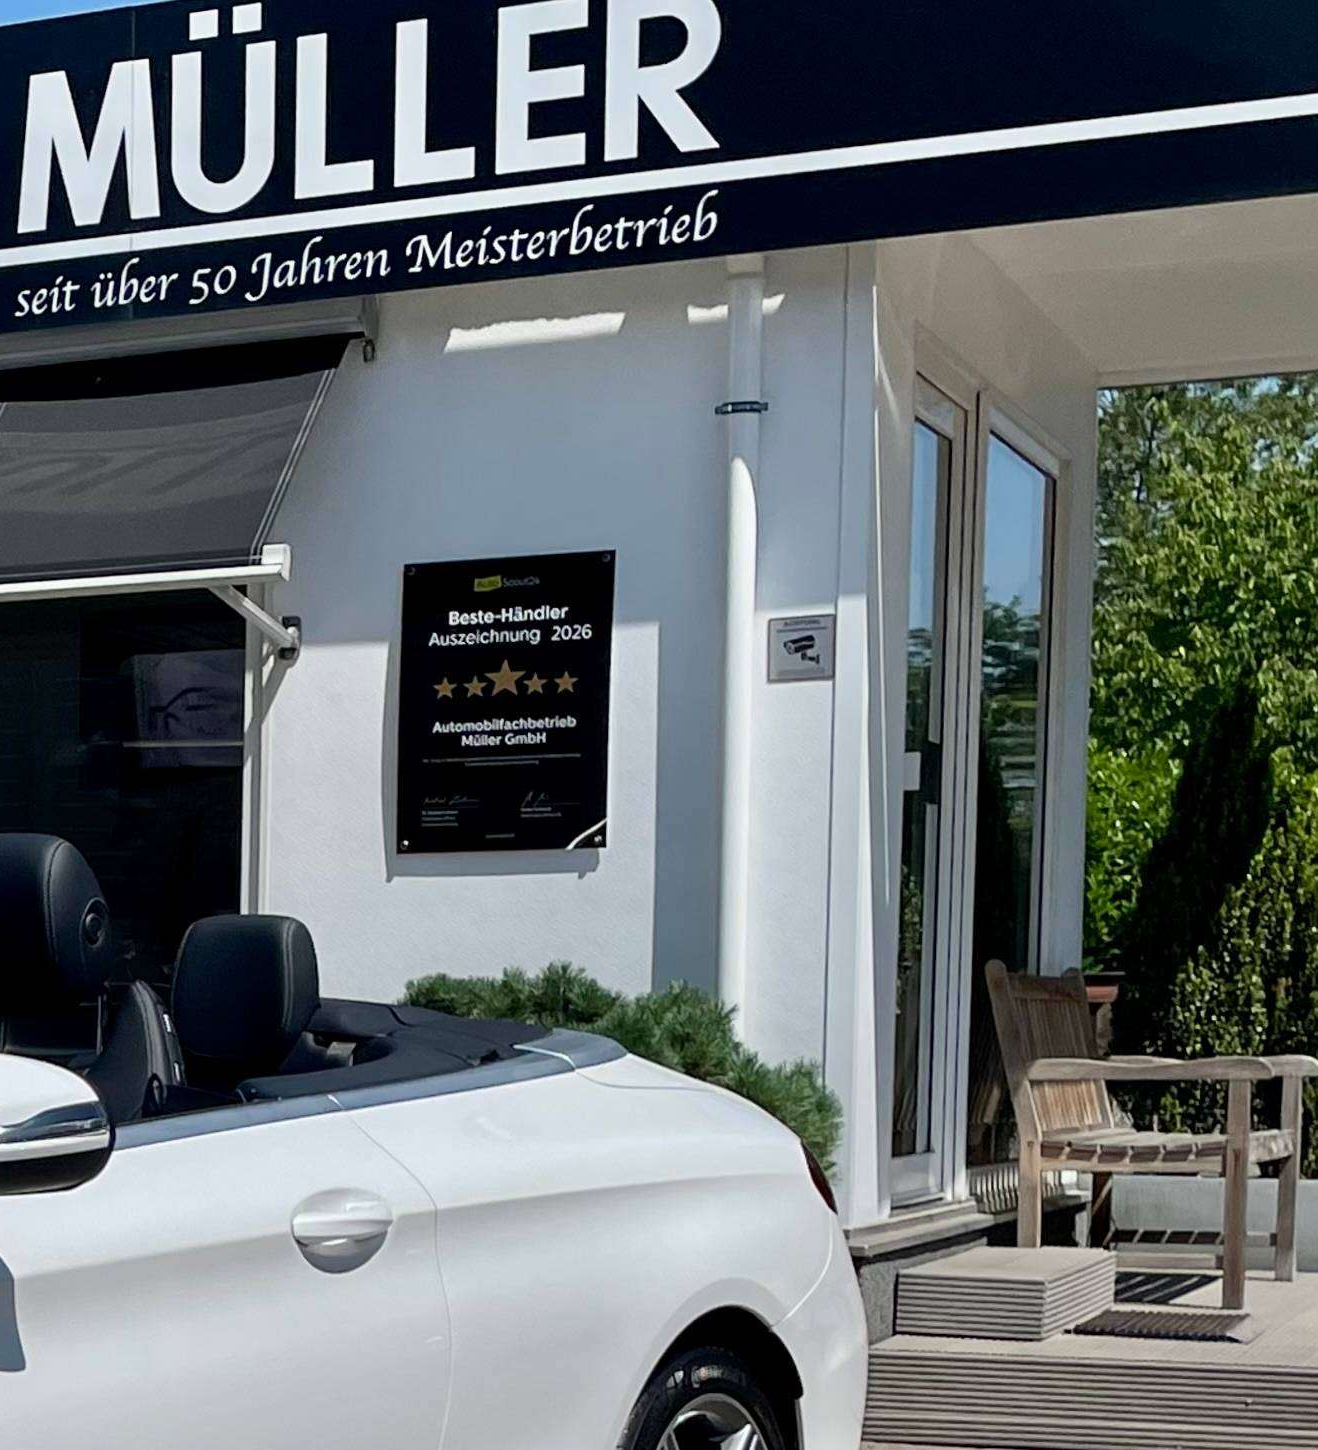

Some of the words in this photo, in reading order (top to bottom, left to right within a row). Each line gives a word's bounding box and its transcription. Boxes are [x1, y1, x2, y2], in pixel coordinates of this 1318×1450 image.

[16, 0, 722, 235] MÜLLER
[14, 277, 79, 317] seit
[91, 259, 177, 308] über
[188, 265, 237, 305] 50
[245, 237, 391, 303] Jahren
[405, 190, 719, 275] Meisterbetrieb
[448, 605, 570, 627] Beste-Händler
[428, 628, 542, 647] Auszeichnung
[550, 624, 593, 641] 2026
[432, 716, 577, 735] Automobilfachbetrieb
[461, 734, 502, 747] Müller
[504, 731, 547, 746] GmbH
